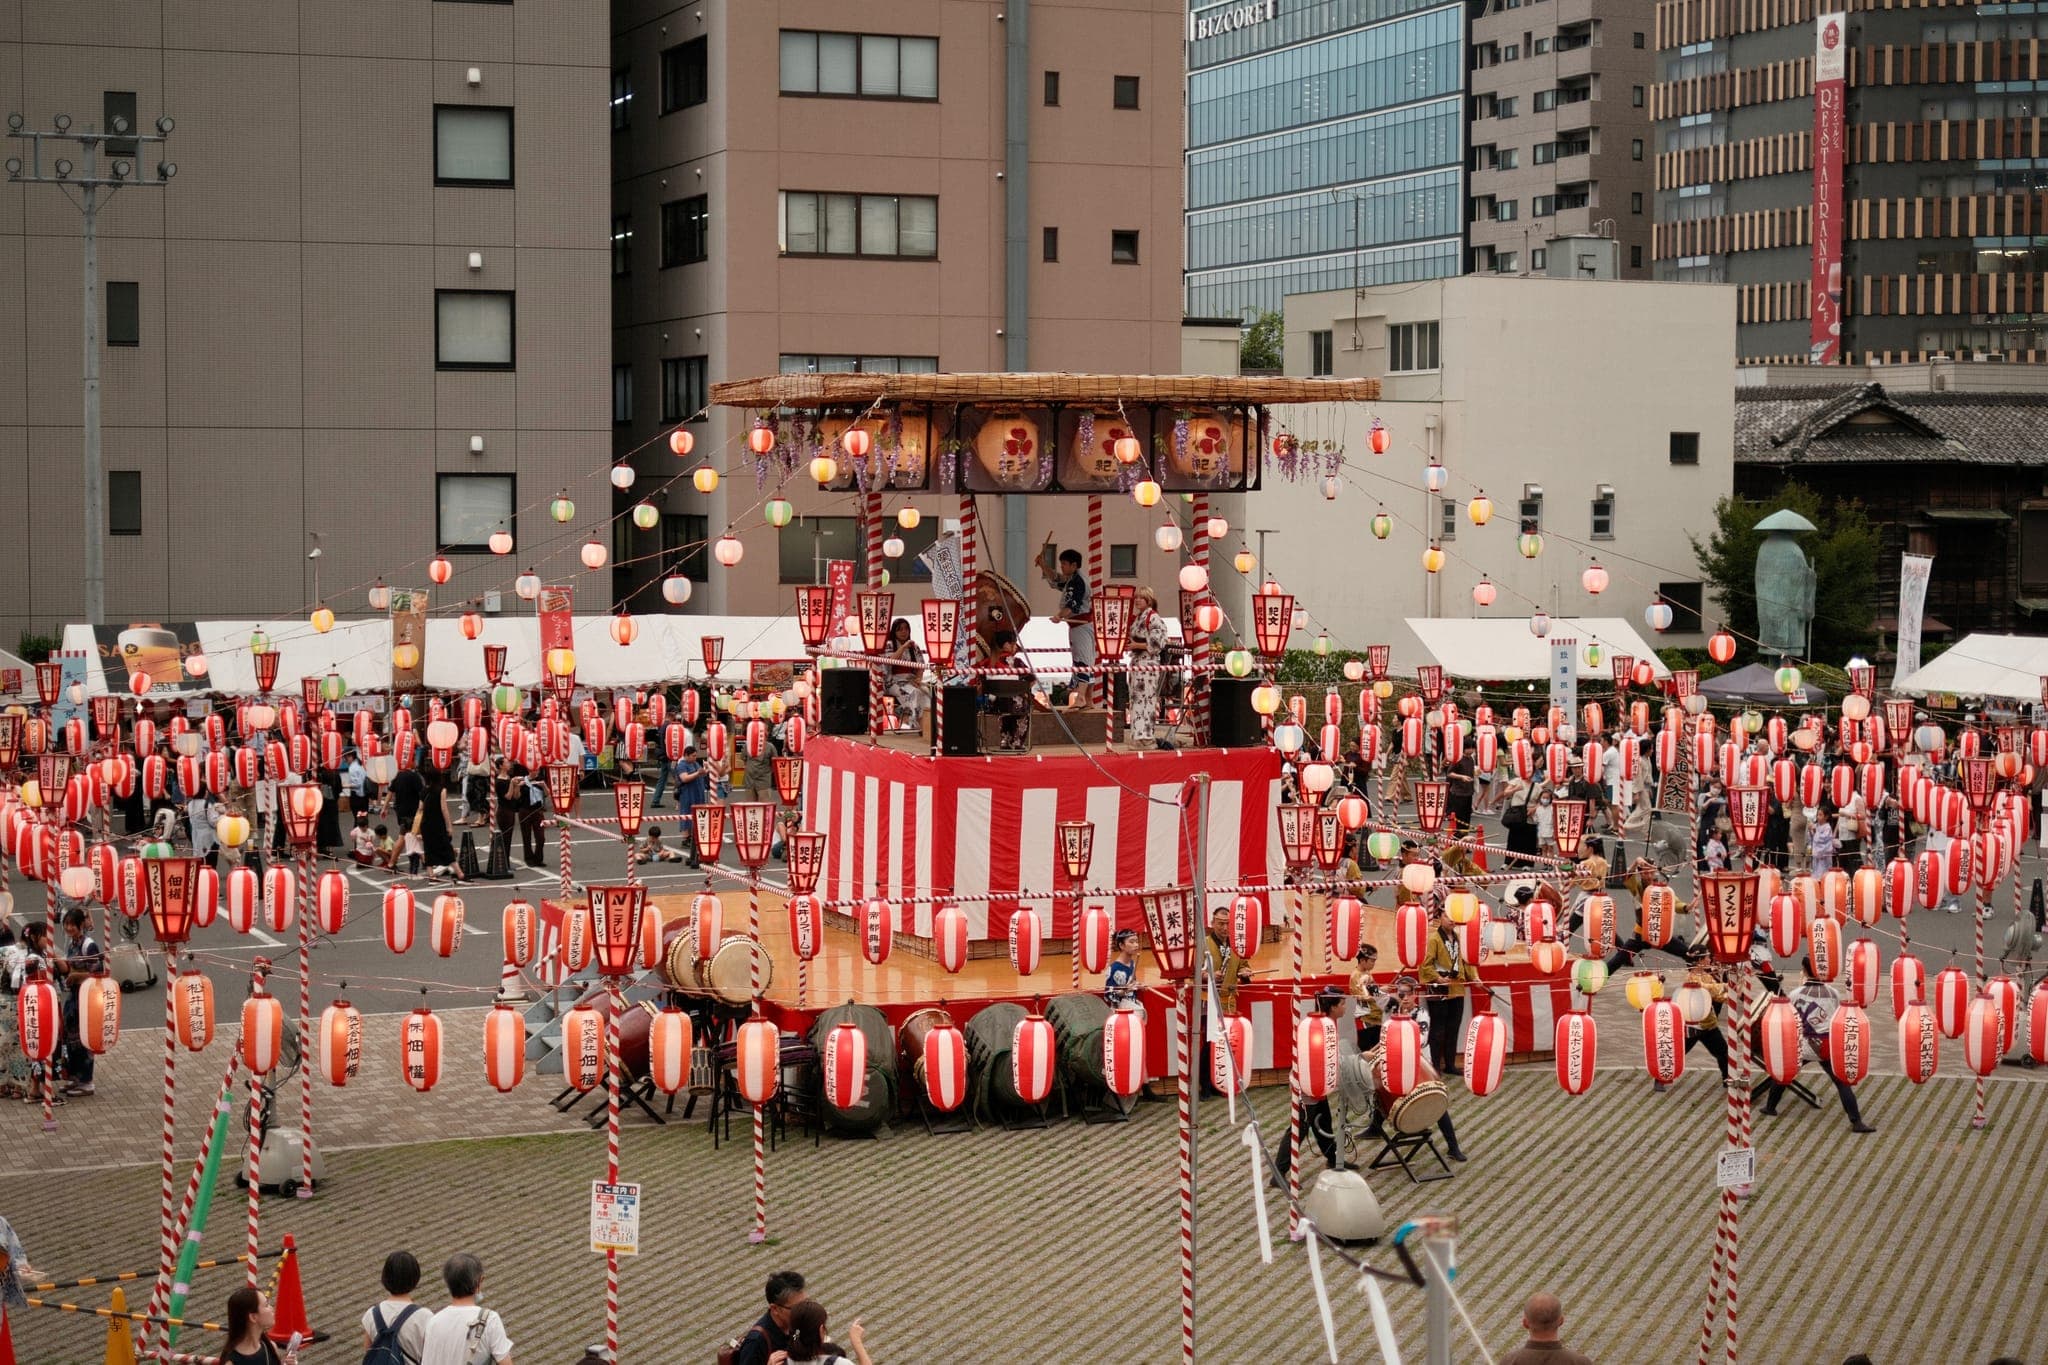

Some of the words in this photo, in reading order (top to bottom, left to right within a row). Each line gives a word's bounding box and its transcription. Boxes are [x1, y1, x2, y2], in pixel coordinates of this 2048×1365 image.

[1198, 3, 1265, 40] BIZCORE
[1818, 88, 1832, 275] RESTAURANT
[812, 598, 822, 617] 紀文
[1268, 607, 1278, 626] 紀文
[928, 613, 937, 632] 紀文
[942, 613, 952, 633] 紀文
[1107, 612, 1118, 636] 紫水
[619, 794, 628, 808] 紀文
[632, 794, 640, 808] 紀文
[1427, 793, 1435, 808] 紀文
[799, 846, 810, 865] 紀文
[1068, 838, 1078, 860] 紫水
[151, 865, 161, 908] つくごん
[1725, 885, 1736, 928] つくごん
[1167, 911, 1184, 947] 紫水
